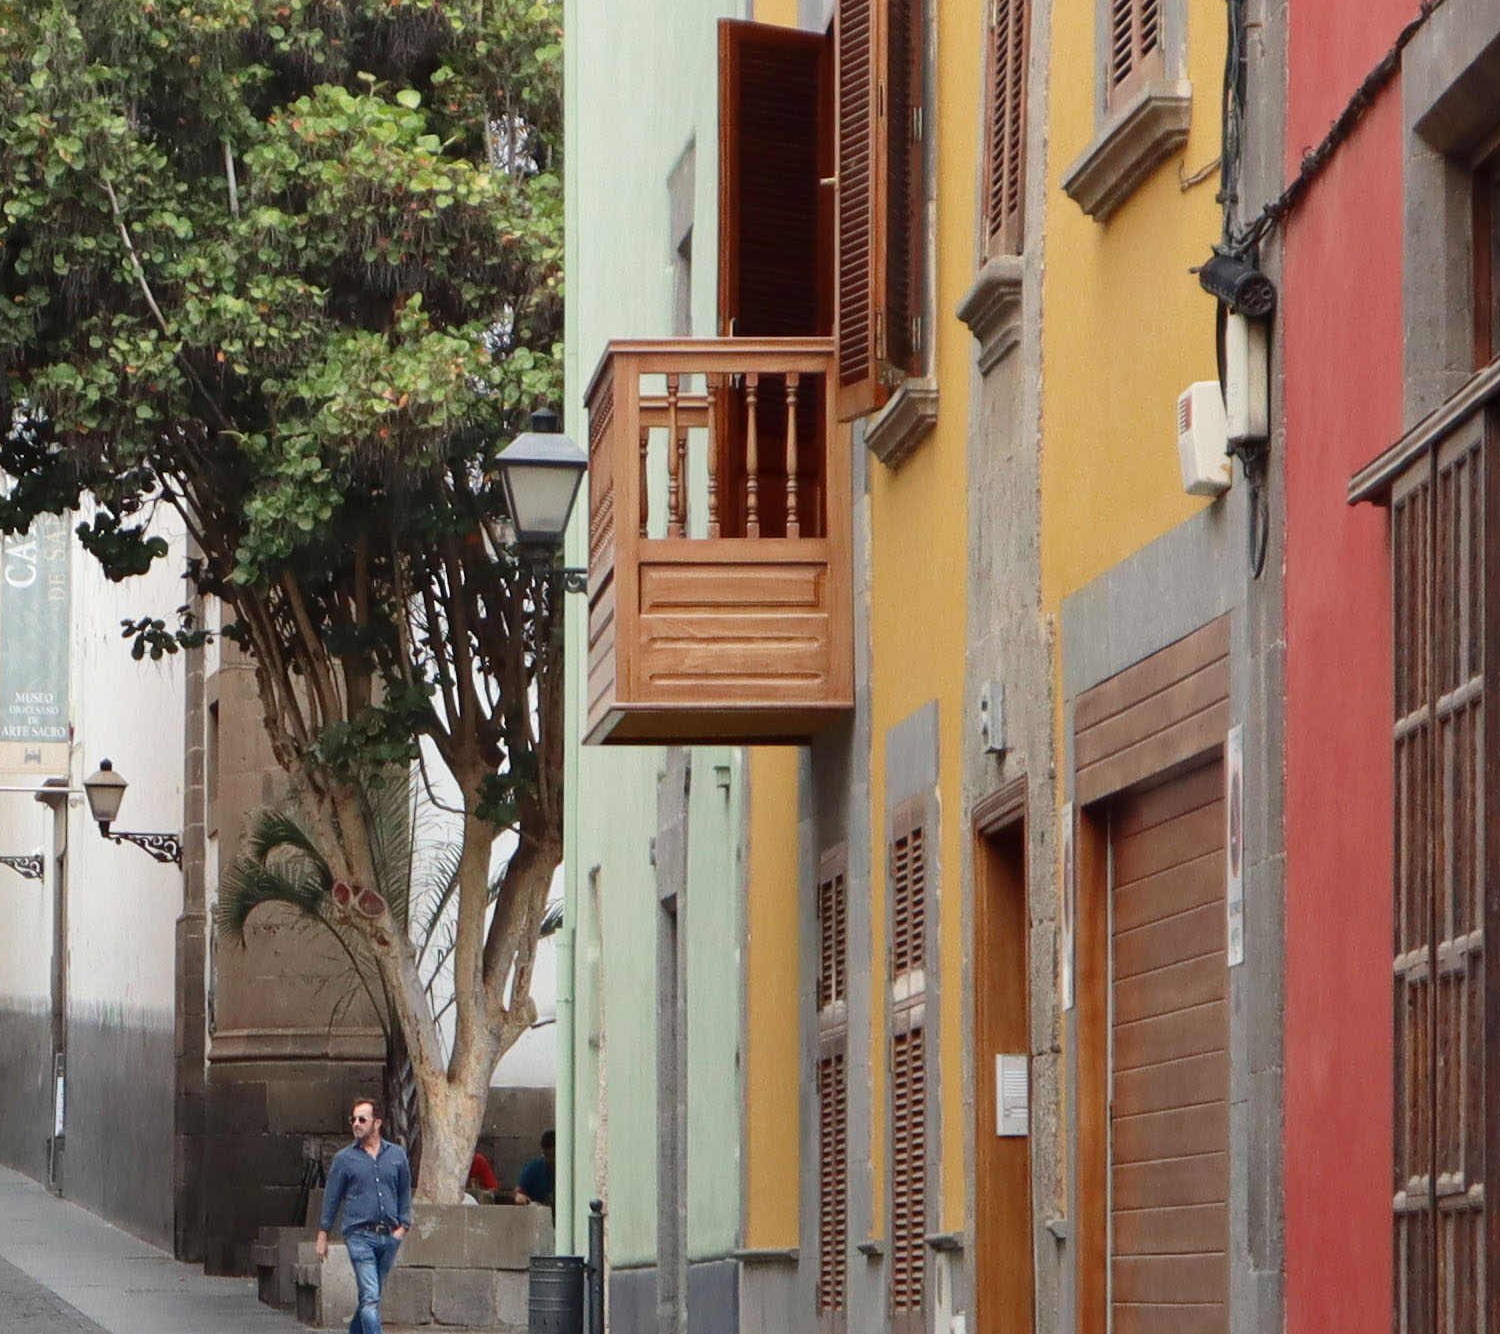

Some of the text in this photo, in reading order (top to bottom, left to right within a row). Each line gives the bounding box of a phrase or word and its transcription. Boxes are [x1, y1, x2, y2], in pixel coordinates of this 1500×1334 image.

[5, 529, 37, 587] CA
[48, 571, 66, 601] DE
[15, 692, 54, 704] MUSEO
[9, 706, 59, 715] DIOCESANO
[28, 716, 39, 725] DE
[2, 726, 66, 738] ARTE SACRO
